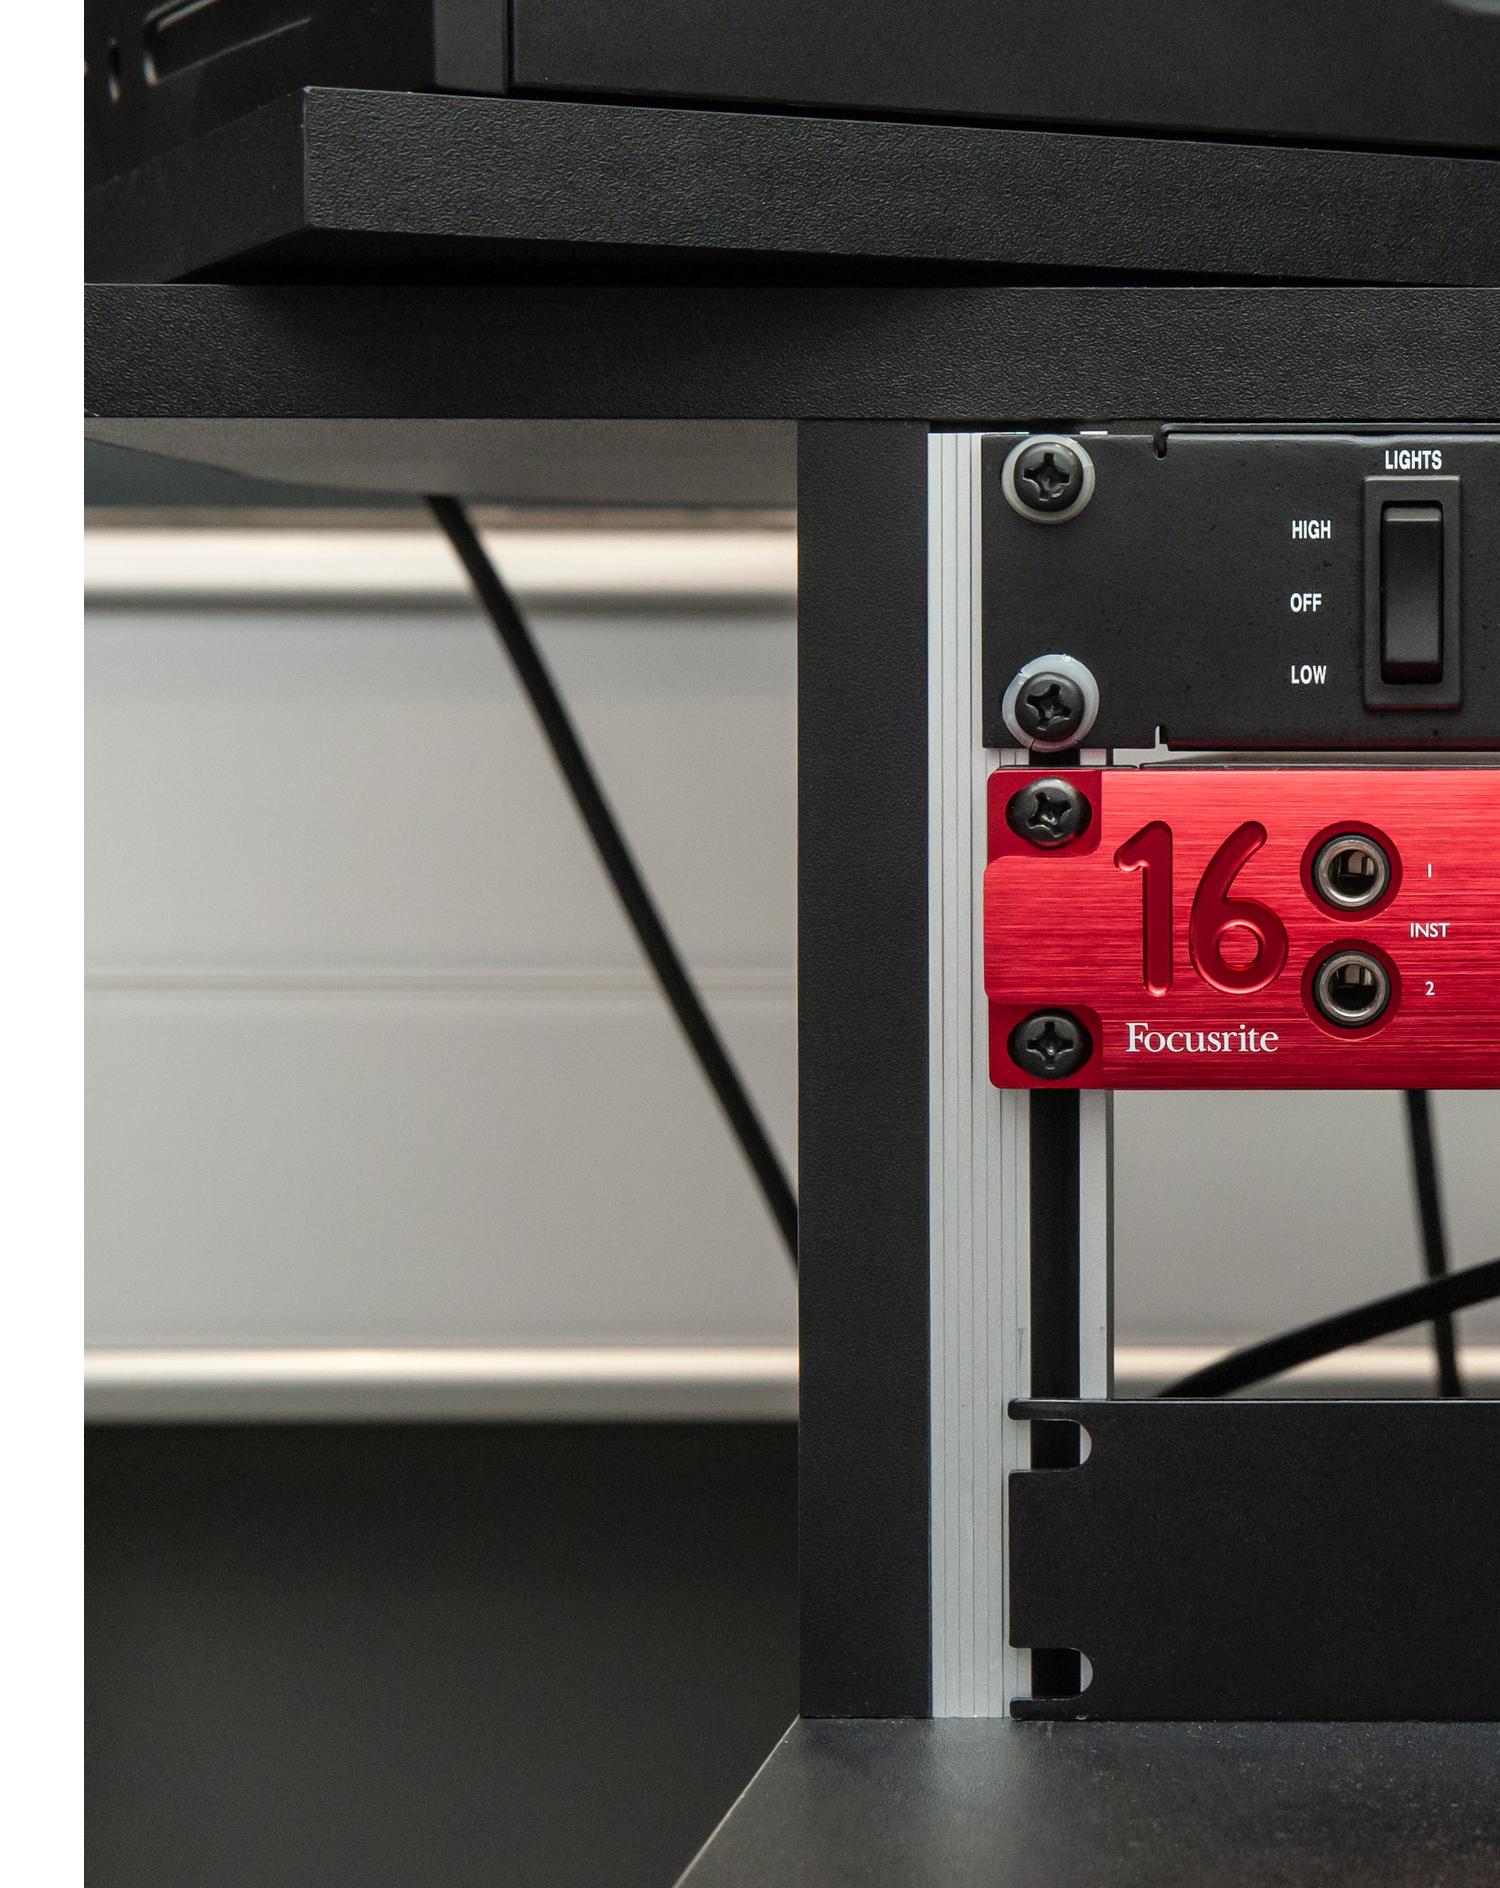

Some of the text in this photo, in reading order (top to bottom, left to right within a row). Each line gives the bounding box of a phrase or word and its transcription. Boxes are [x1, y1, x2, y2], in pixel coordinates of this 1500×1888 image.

[1385, 449, 1443, 470] LIGHTS
[1292, 519, 1331, 540] HIGH
[1290, 592, 1322, 613] OFF
[1291, 664, 1327, 685] LOW
[1113, 819, 1291, 998] 16
[1410, 922, 1451, 938] INST
[1425, 980, 1435, 996] 2
[1125, 1022, 1279, 1053] Focusrite
